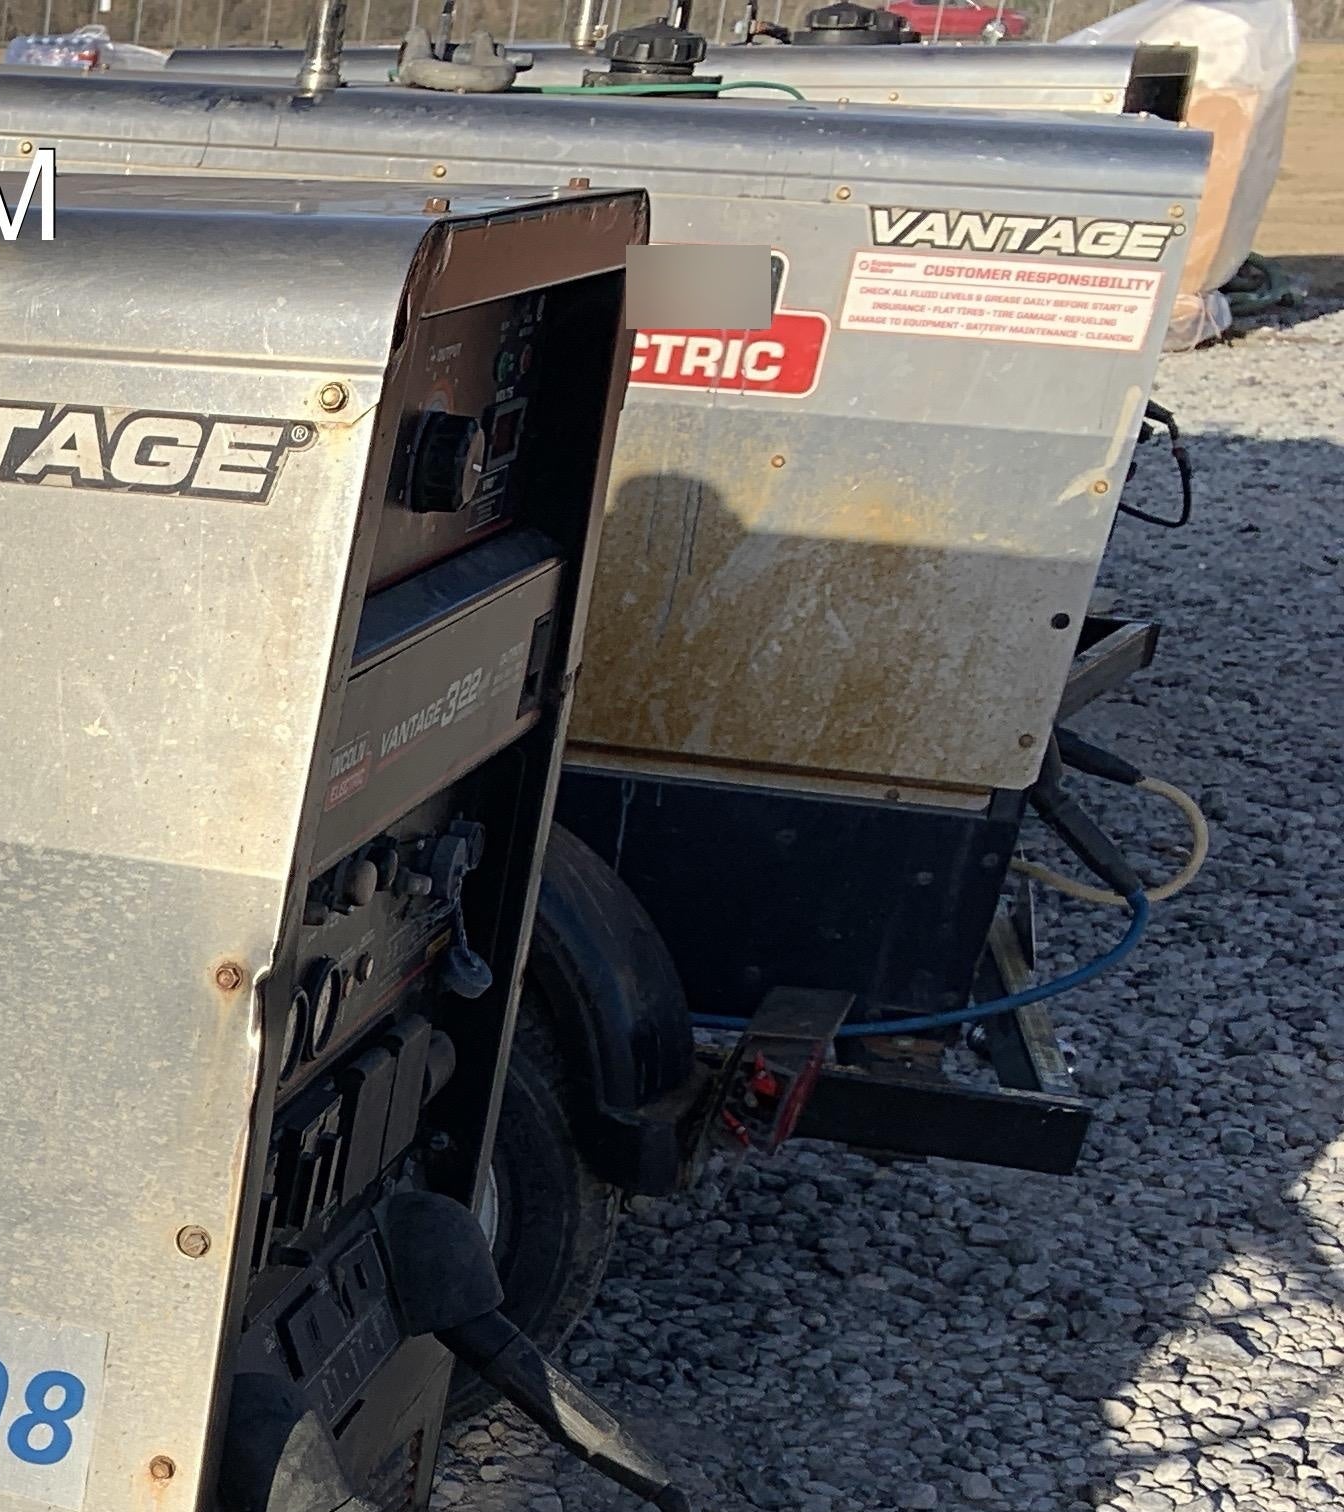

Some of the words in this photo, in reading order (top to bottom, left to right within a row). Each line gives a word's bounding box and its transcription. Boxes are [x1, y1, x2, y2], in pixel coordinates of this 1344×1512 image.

[873, 209, 1173, 259] VANTAGE
[923, 264, 1012, 281] CUSTOMER
[1015, 269, 1155, 292] RESPONSIBILITY
[859, 286, 890, 296] CHECK
[891, 287, 909, 297] ALL
[910, 289, 939, 299] FLUID
[939, 291, 974, 301] LEVELS
[984, 294, 1021, 305] GREASE
[1023, 297, 1051, 307] DAILY
[1053, 299, 1089, 310] BEFORE
[1091, 302, 1121, 312] START
[1123, 305, 1138, 314] UP
[847, 314, 887, 325] DAMAGE
[889, 317, 902, 326] TO
[903, 318, 960, 329] EQUIPMENT
[965, 322, 1009, 332] BATTERY
[1009, 326, 1078, 339] MAINTENANCE
[1085, 332, 1134, 343] CLEANING
[872, 302, 927, 313] INSURANCE
[932, 305, 955, 315] FLAT
[957, 307, 986, 317] TIRES
[992, 309, 1015, 318] TIRE
[1016, 311, 1058, 322] DAMAGE
[1064, 315, 1118, 327] REFUELING
[380, 698, 443, 758] VANTAGE
[440, 666, 484, 729] 322
